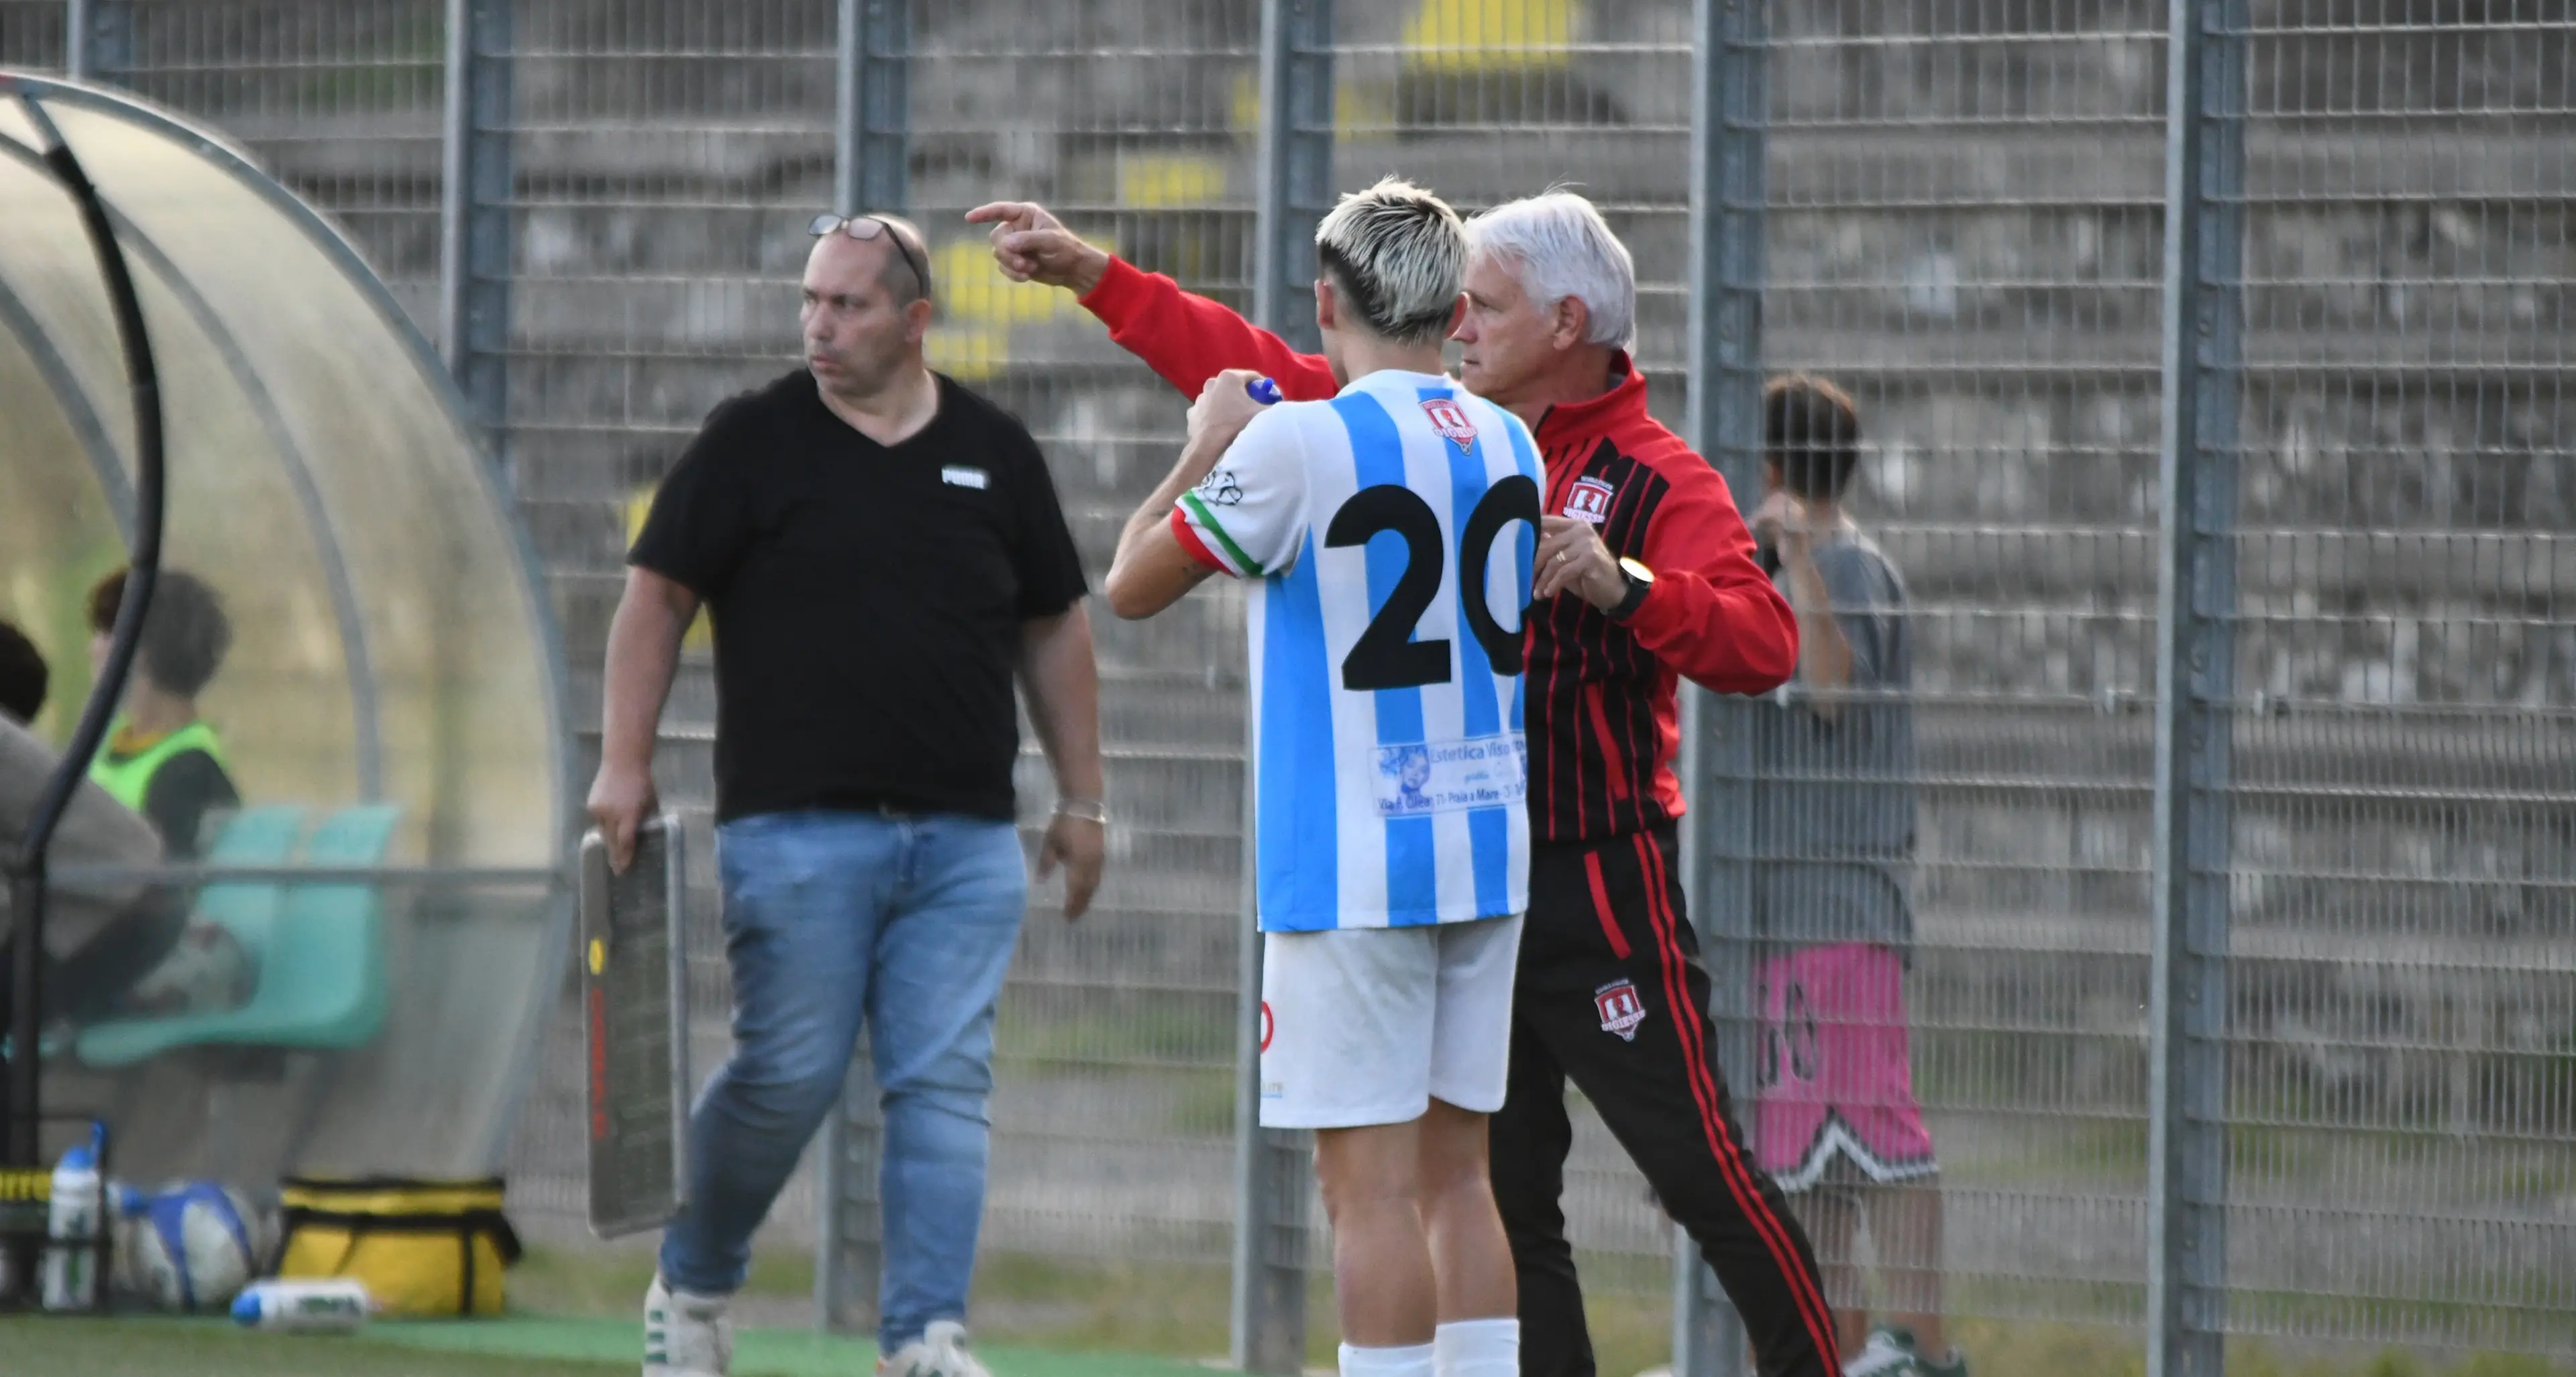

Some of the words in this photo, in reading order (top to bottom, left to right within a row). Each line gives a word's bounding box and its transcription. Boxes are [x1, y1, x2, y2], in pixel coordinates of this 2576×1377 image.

[1324, 475, 1542, 690] 20
[1430, 745, 1485, 763] Estetica
[1448, 791, 1468, 804] Praia
[1477, 788, 1499, 801] Mare
